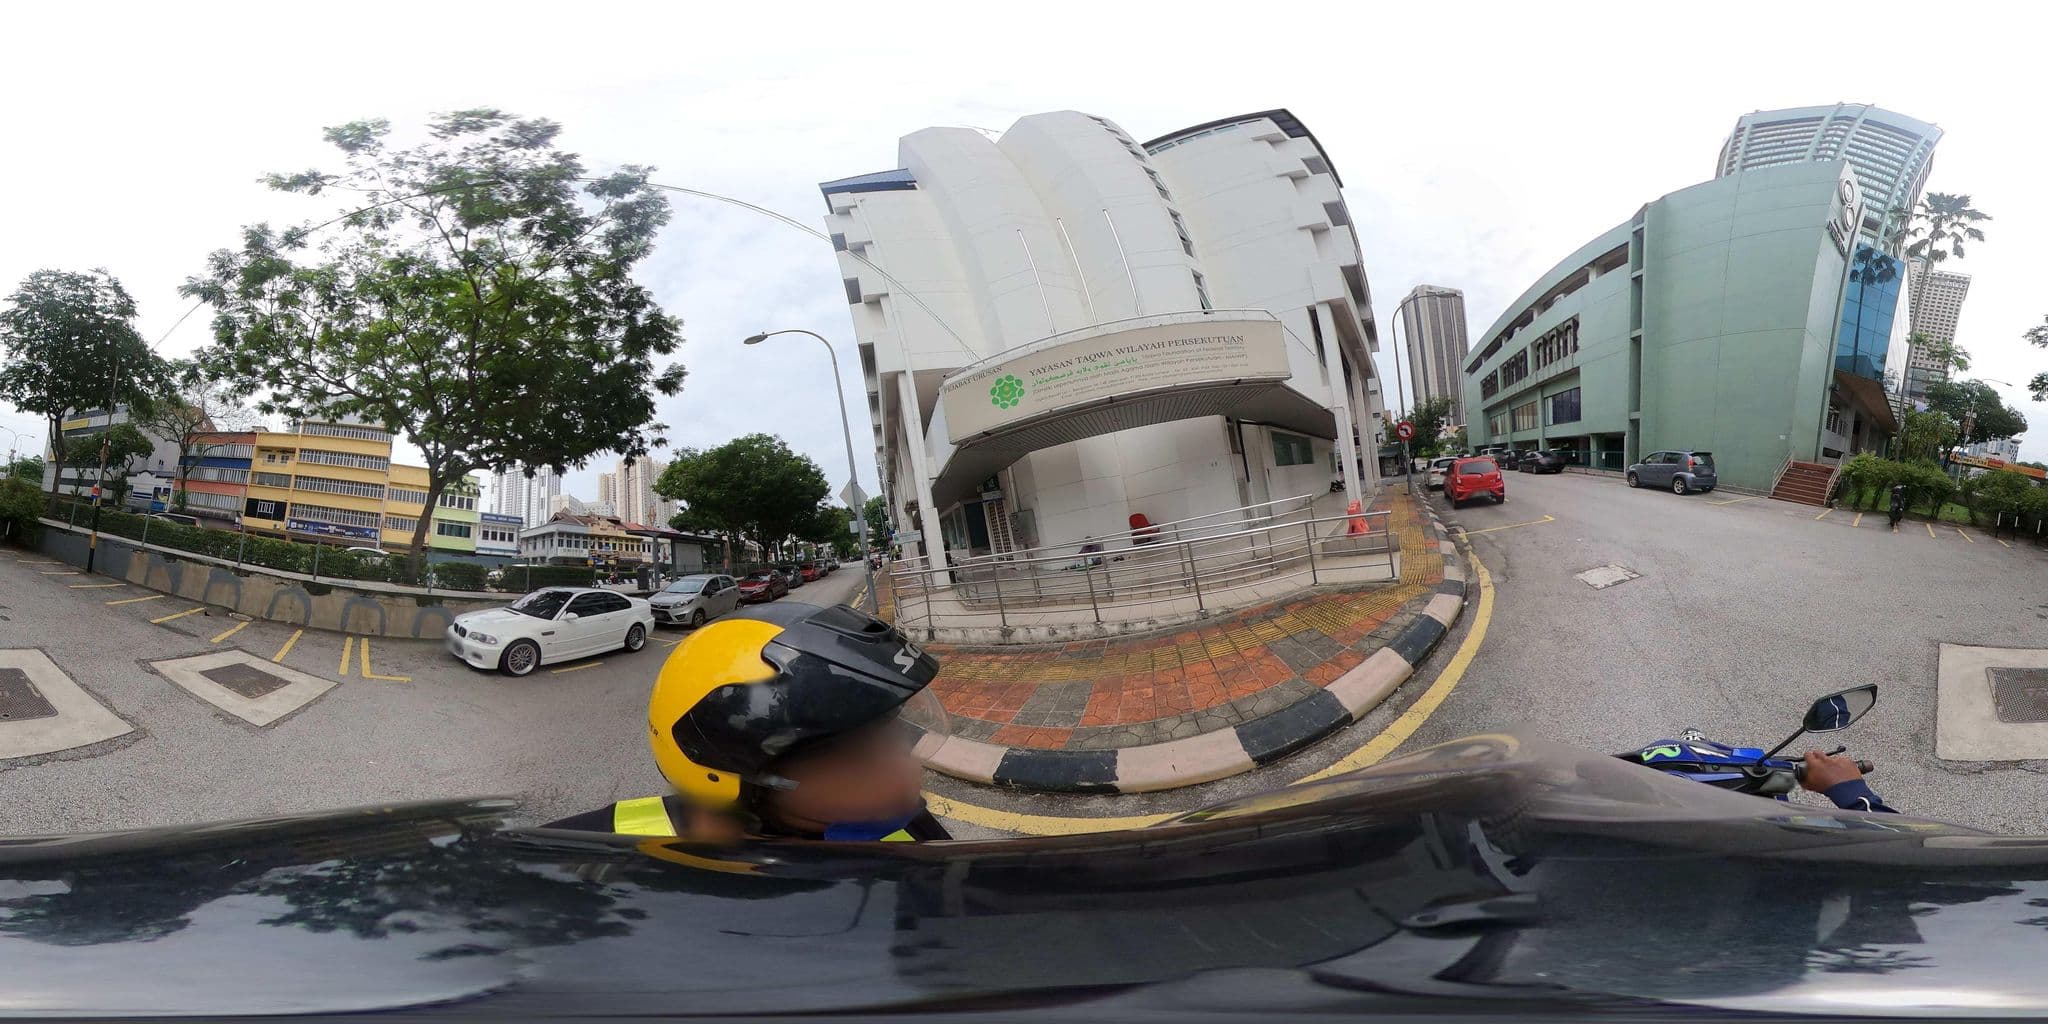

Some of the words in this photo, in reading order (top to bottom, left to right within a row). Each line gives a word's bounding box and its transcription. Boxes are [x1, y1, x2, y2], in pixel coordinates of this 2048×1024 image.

[1030, 359, 1073, 377] YAYASAN
[1075, 351, 1114, 364] TAQWA
[1115, 341, 1166, 355] WILAYAH
[1168, 335, 1244, 348] PERSEKUTUAN
[971, 367, 1003, 383] URUSAN
